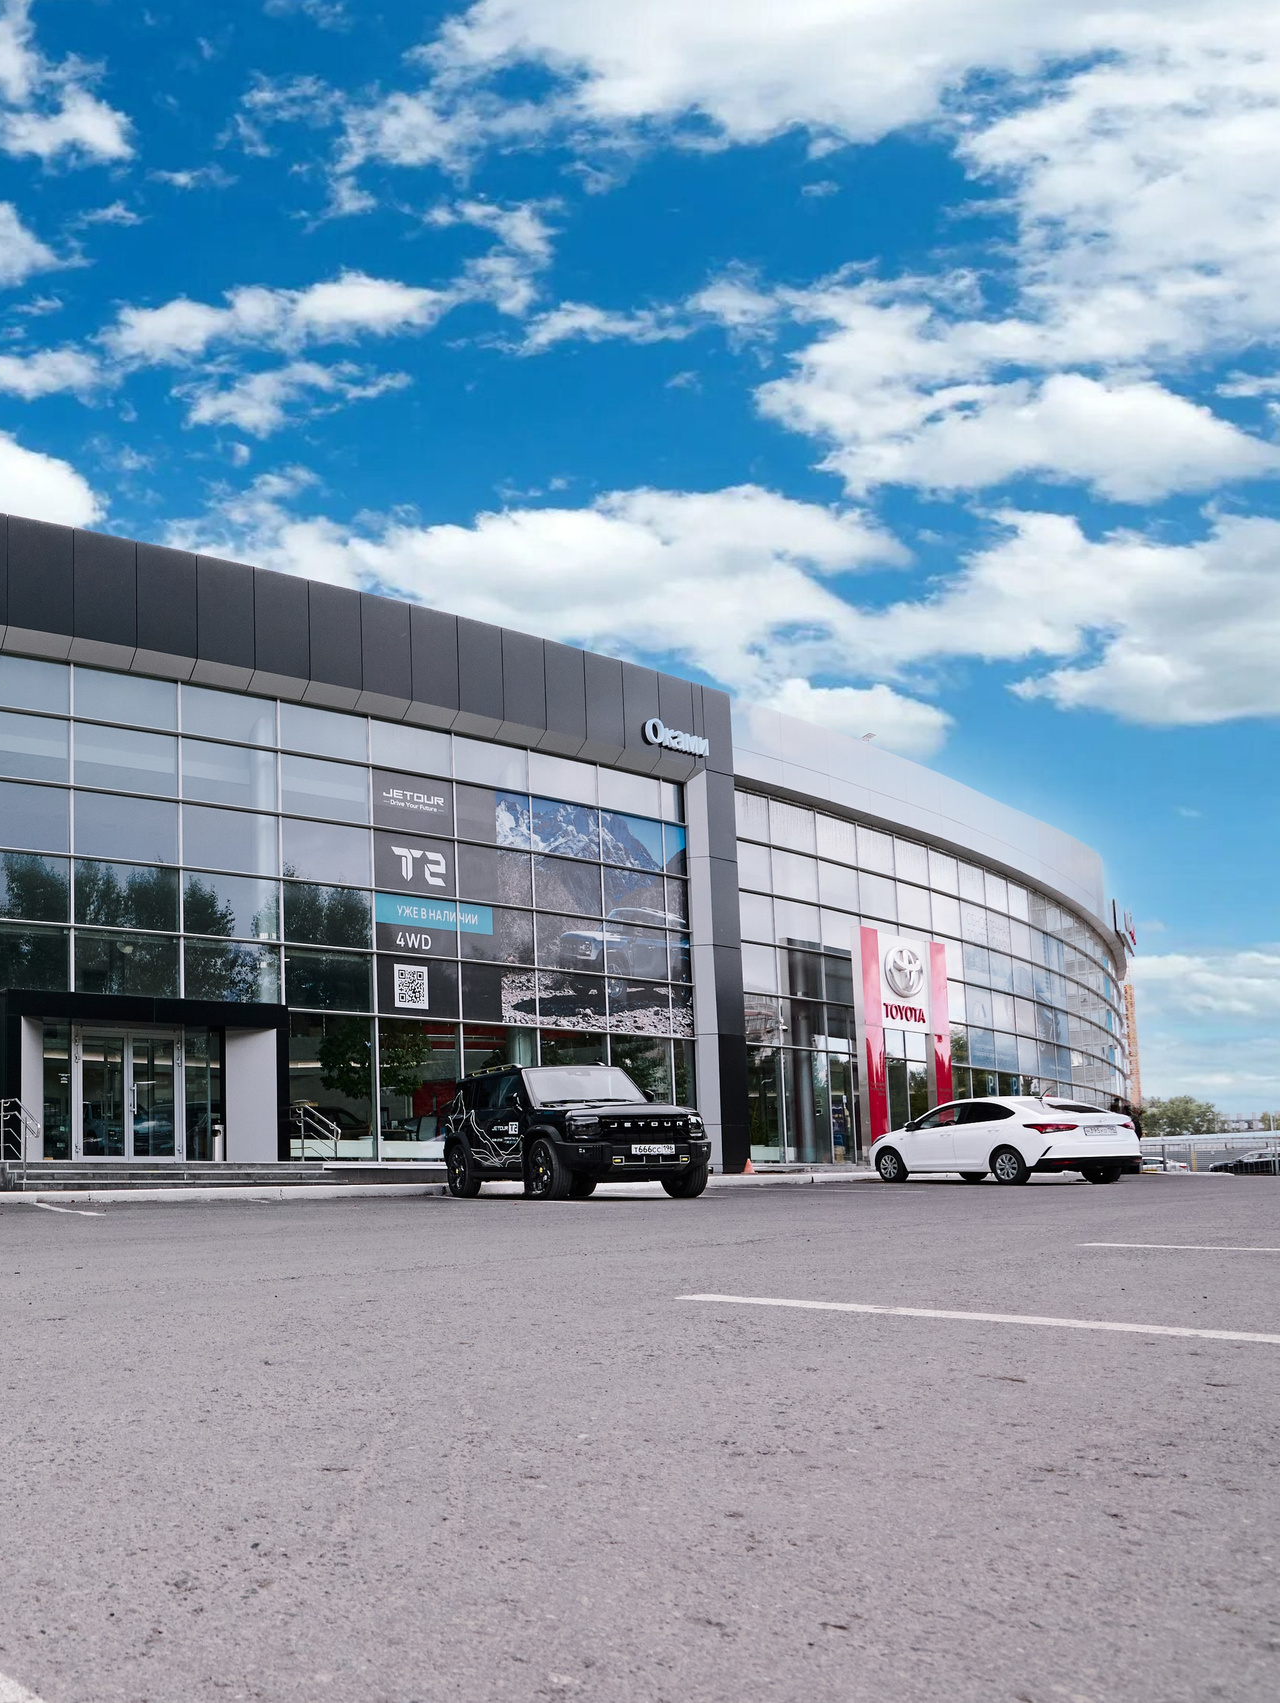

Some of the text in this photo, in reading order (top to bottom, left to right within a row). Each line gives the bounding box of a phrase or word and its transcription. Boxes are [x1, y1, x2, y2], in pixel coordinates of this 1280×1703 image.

[383, 788, 444, 807] JETOUR
[390, 799, 437, 812] Drive Your Future
[390, 846, 446, 887] T2
[396, 905, 478, 925] УЖЕ В НАЛИЧИИ
[396, 932, 432, 950] 4WD
[883, 1002, 926, 1024] TOYOTA
